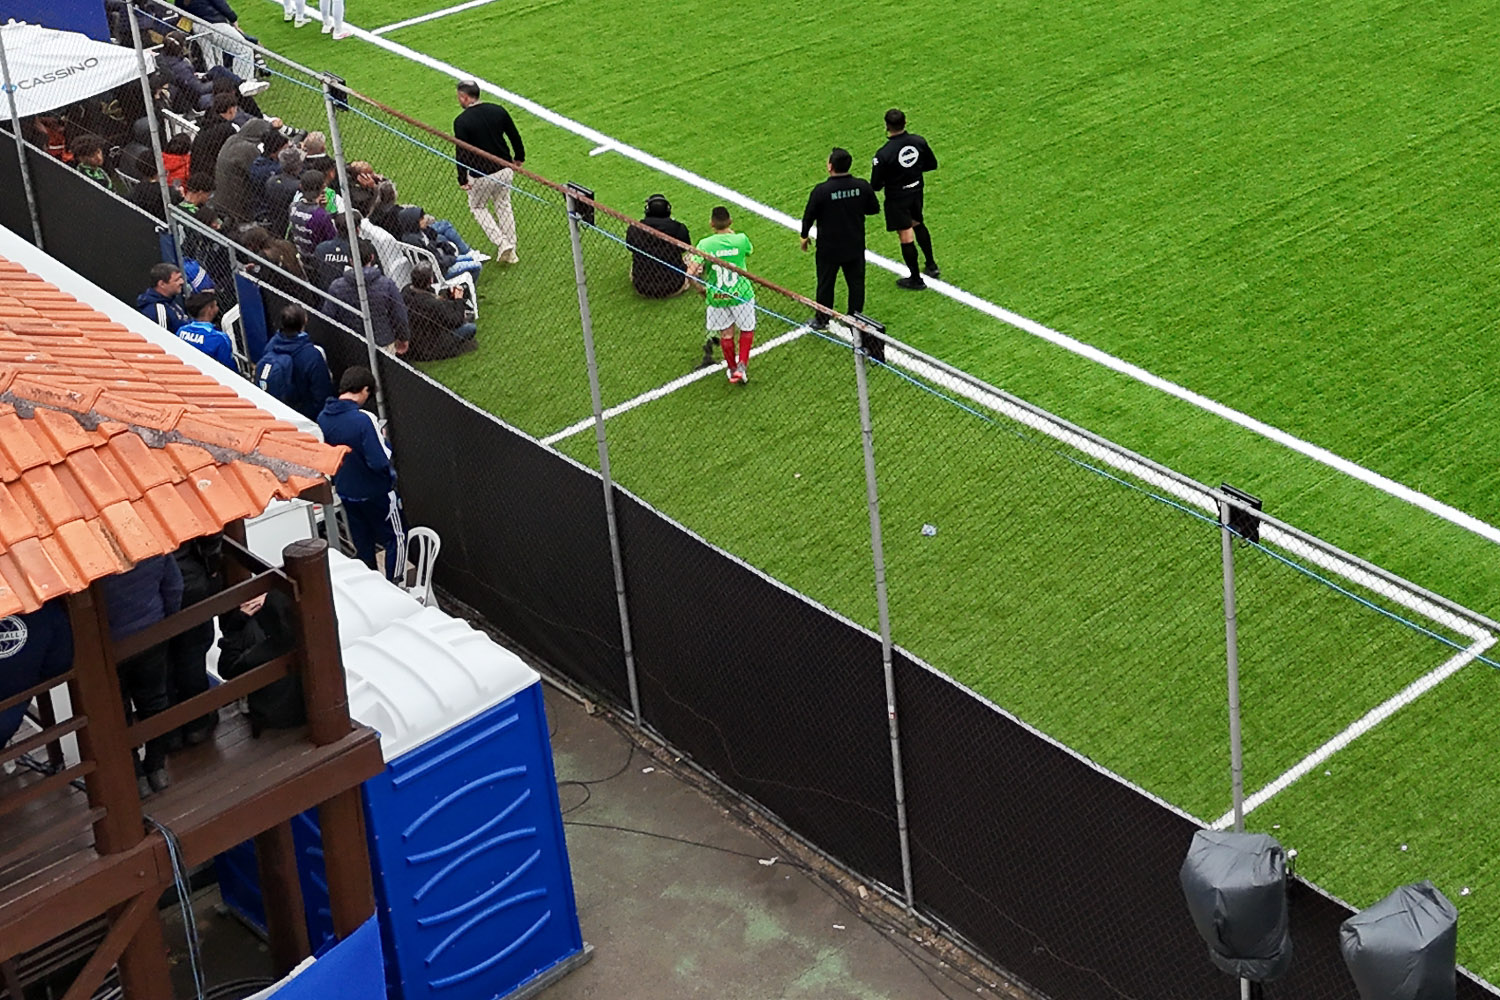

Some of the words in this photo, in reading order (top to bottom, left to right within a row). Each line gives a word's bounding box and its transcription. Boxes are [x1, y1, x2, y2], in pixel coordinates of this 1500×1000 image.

[17, 57, 99, 90] CASSINO
[324, 253, 349, 264] ITALIA
[179, 330, 205, 345] ITALIA
